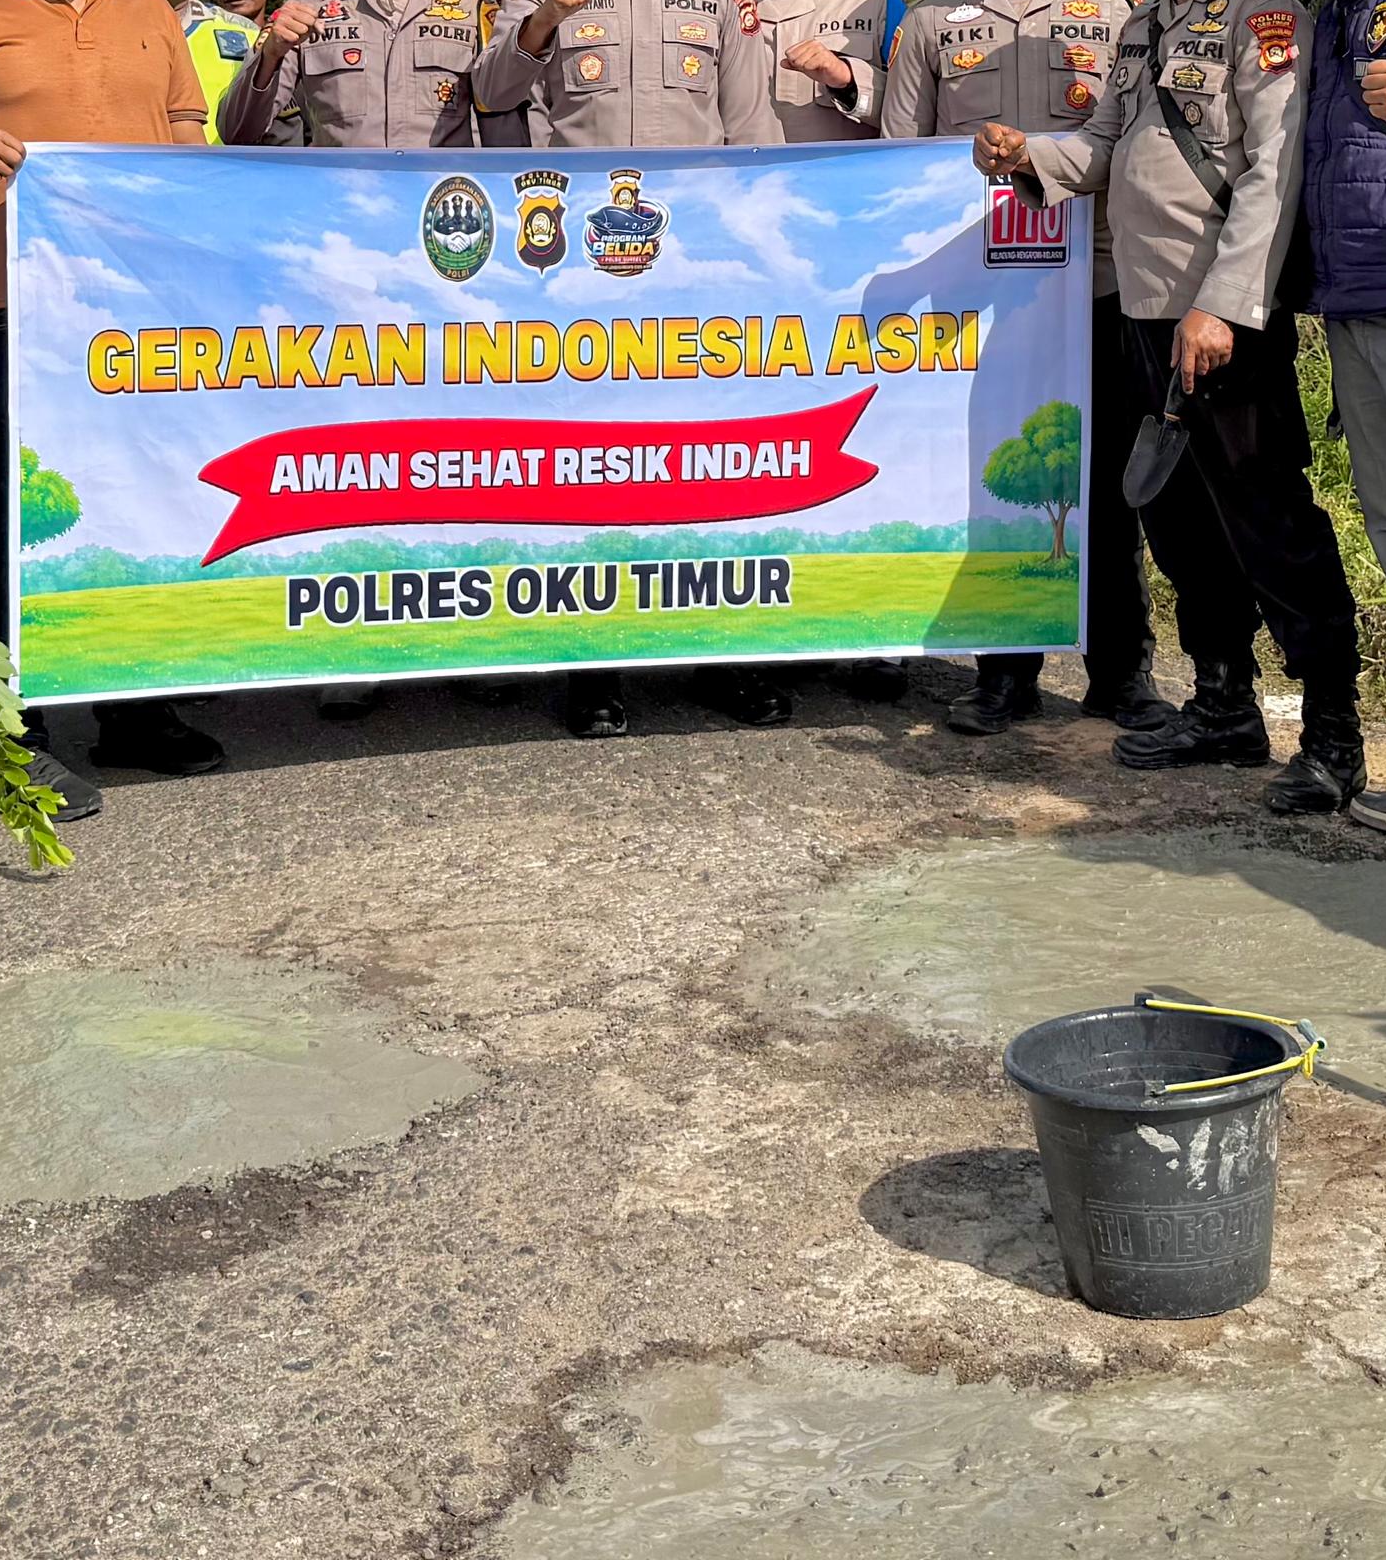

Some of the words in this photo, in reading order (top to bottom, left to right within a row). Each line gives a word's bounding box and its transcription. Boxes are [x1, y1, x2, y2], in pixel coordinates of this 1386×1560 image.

[419, 24, 471, 43] POLRI
[819, 18, 872, 34] POLRI
[939, 25, 995, 44] KIKI
[1050, 24, 1111, 43] POLRI
[1173, 39, 1224, 60] POLRI
[592, 241, 655, 256] BELIDA
[85, 320, 429, 395] GERAKAN
[442, 315, 814, 386] INDONESIA
[825, 312, 980, 375] ASRI
[269, 450, 400, 494] AMAN
[408, 446, 548, 490] SEHAT
[553, 443, 673, 486] RESIK
[679, 438, 813, 481] INDAH
[286, 568, 494, 627] POLRES
[503, 562, 618, 615] OKU
[628, 556, 793, 610] TIMUR
